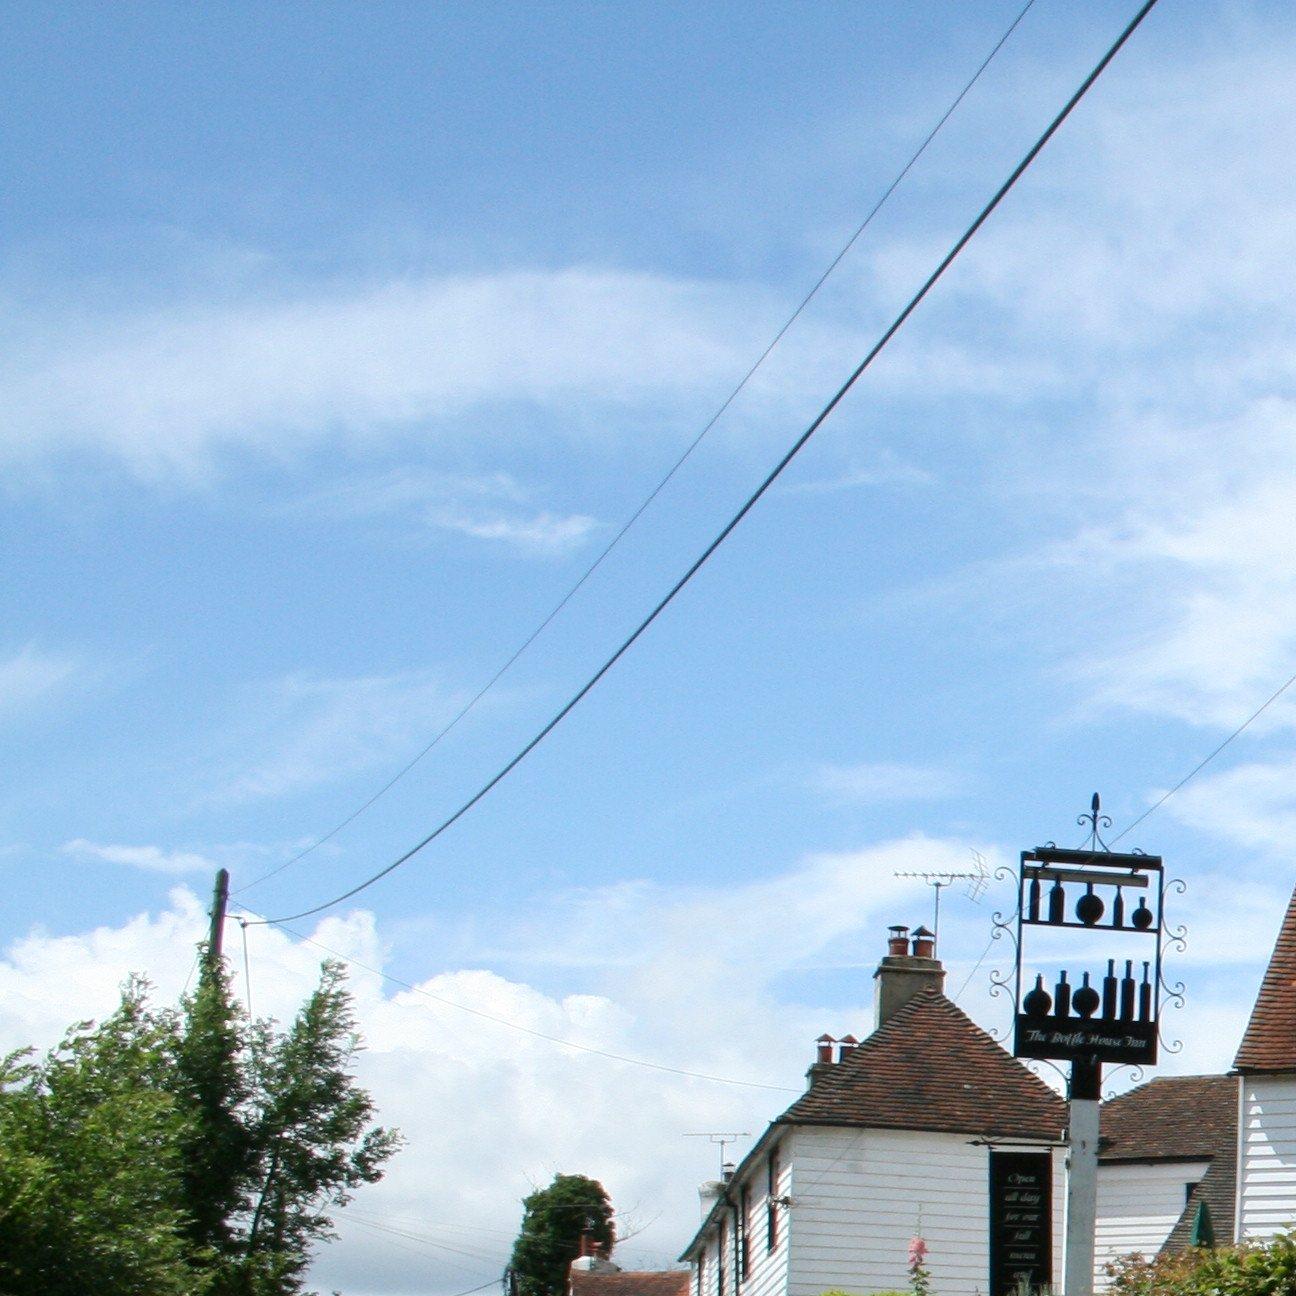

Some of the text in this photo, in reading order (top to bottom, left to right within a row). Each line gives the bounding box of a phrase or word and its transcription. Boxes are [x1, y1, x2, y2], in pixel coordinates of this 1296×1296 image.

[1027, 1030, 1147, 1048] The Bottle House Inn
